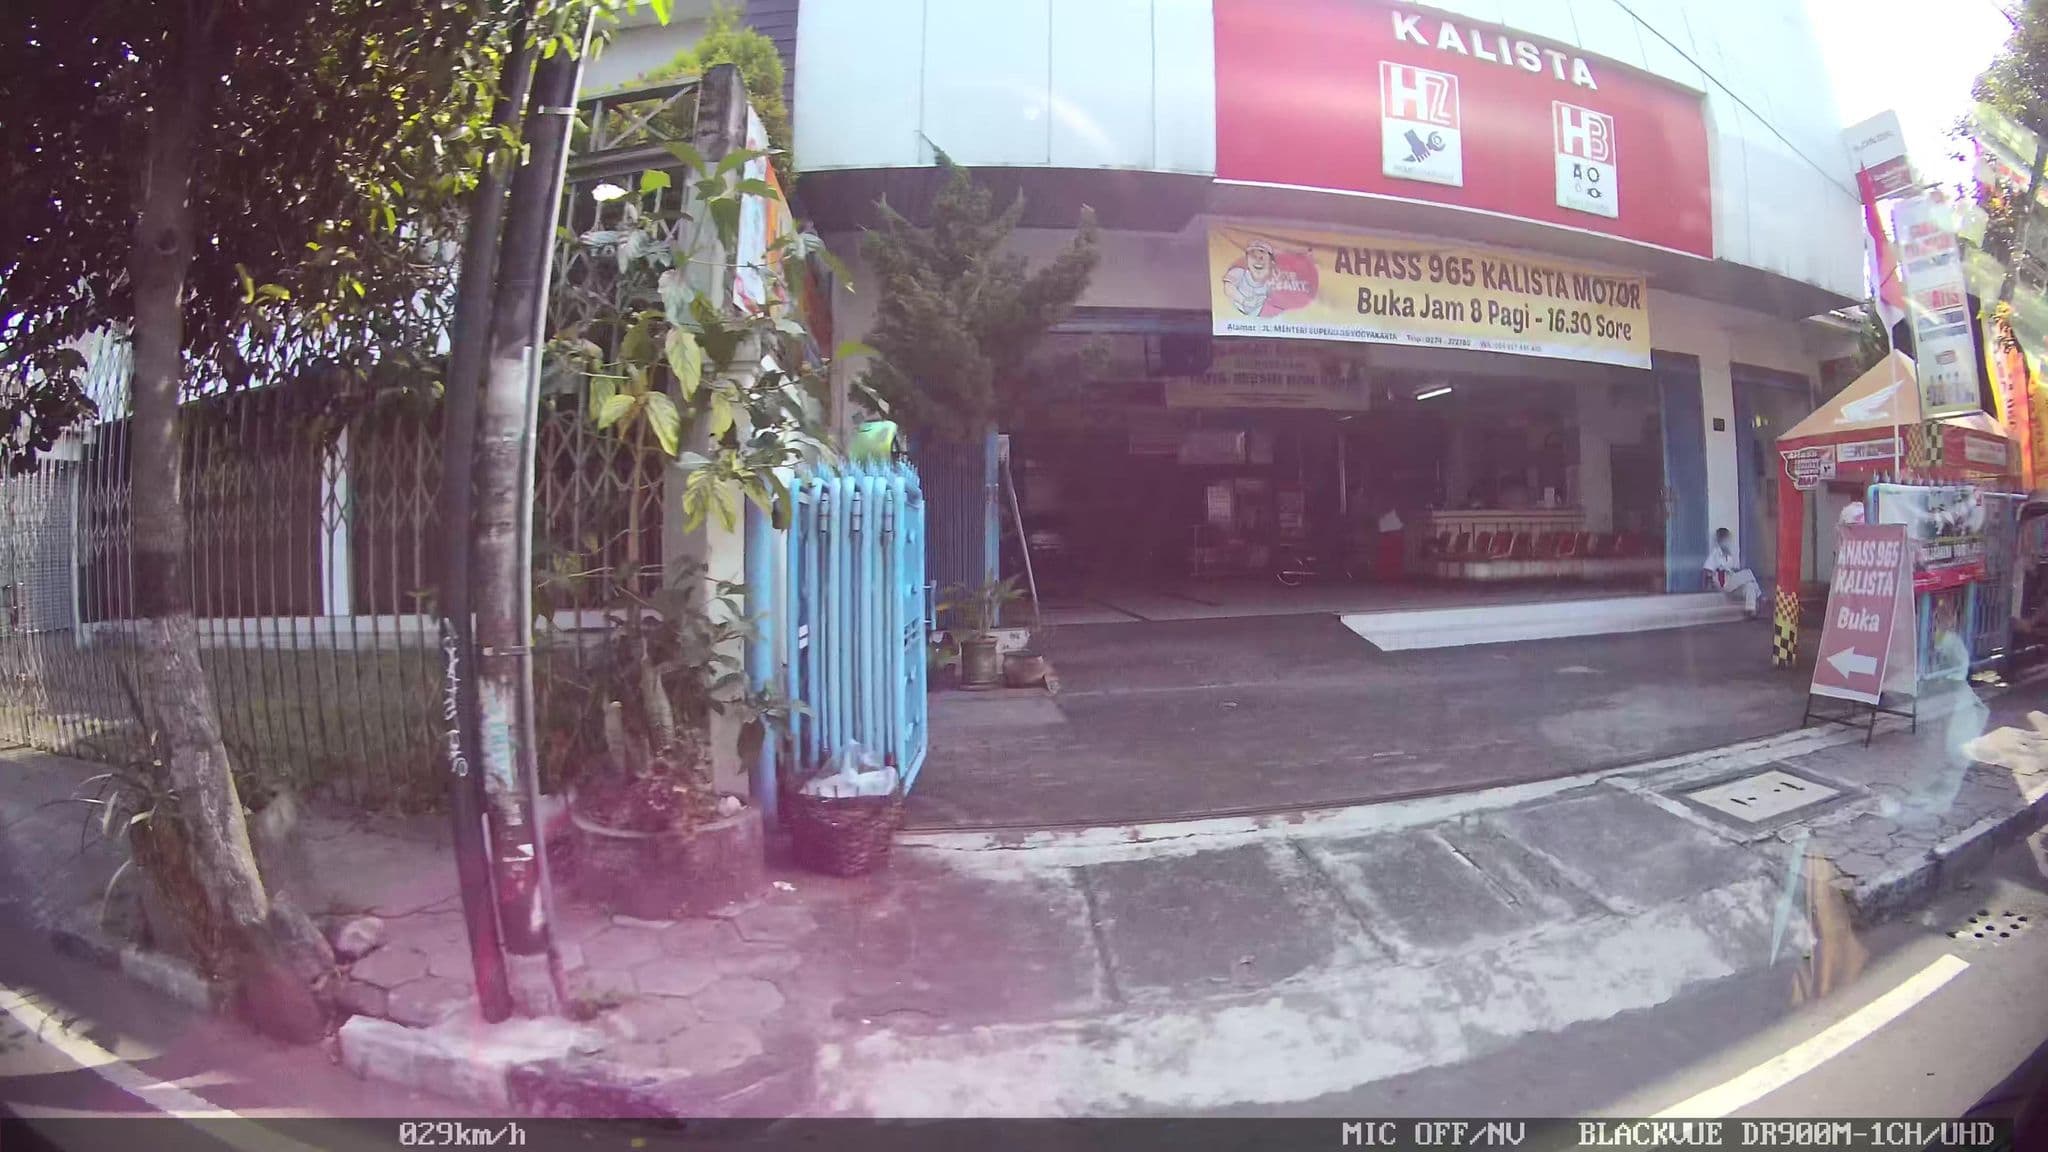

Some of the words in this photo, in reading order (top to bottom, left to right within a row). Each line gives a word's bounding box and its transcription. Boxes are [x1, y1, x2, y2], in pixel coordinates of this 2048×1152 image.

[1391, 10, 1598, 90] KALISTA
[1334, 247, 1422, 282] AHASS
[1428, 254, 1476, 288] 965
[1481, 260, 1570, 300] KALISTA
[1573, 274, 1641, 310] MOTOR
[1356, 286, 1416, 318] Buka
[1419, 293, 1465, 323] Jam
[1469, 298, 1483, 324] 8
[1487, 299, 1530, 334] Pagi
[1547, 306, 1592, 336] 16.30
[1596, 314, 1632, 342] Sore
[1836, 539, 1876, 567] AHASS
[1876, 540, 1901, 568] 965
[1834, 567, 1894, 598] KALISTA
[1837, 606, 1881, 633] Buka
